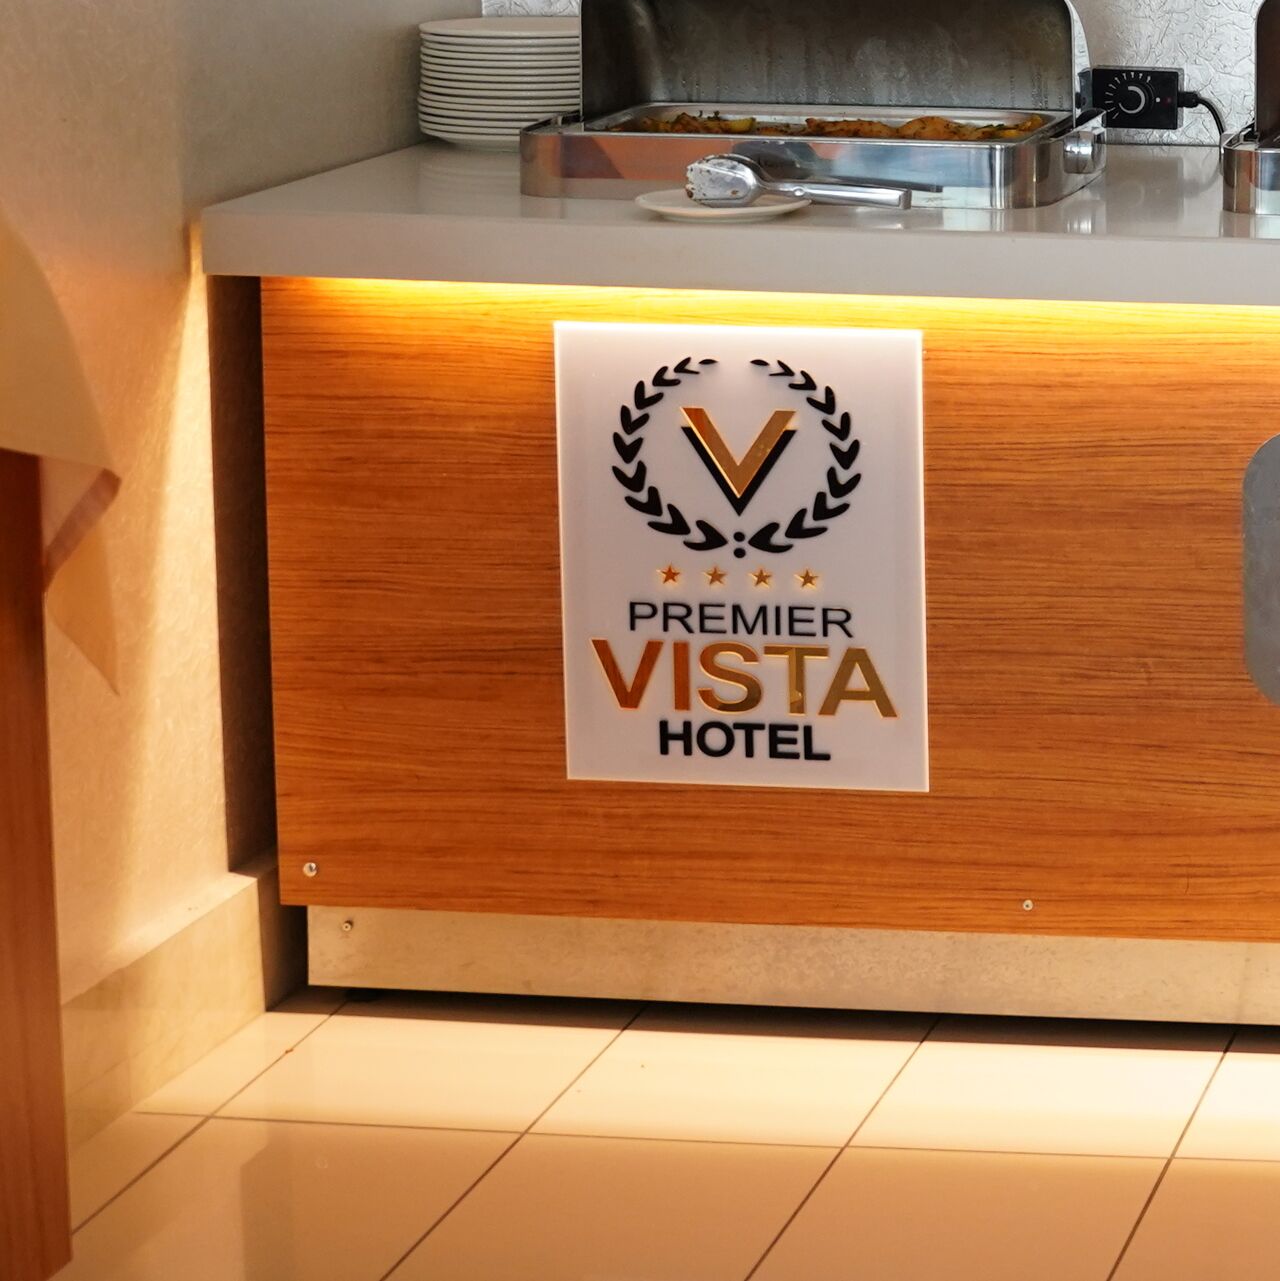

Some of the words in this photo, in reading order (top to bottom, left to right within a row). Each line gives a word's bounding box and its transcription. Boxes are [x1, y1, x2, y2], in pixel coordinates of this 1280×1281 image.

[628, 601, 854, 639] PREMIER
[591, 638, 898, 718] VISTA
[658, 719, 832, 762] HOTEL
